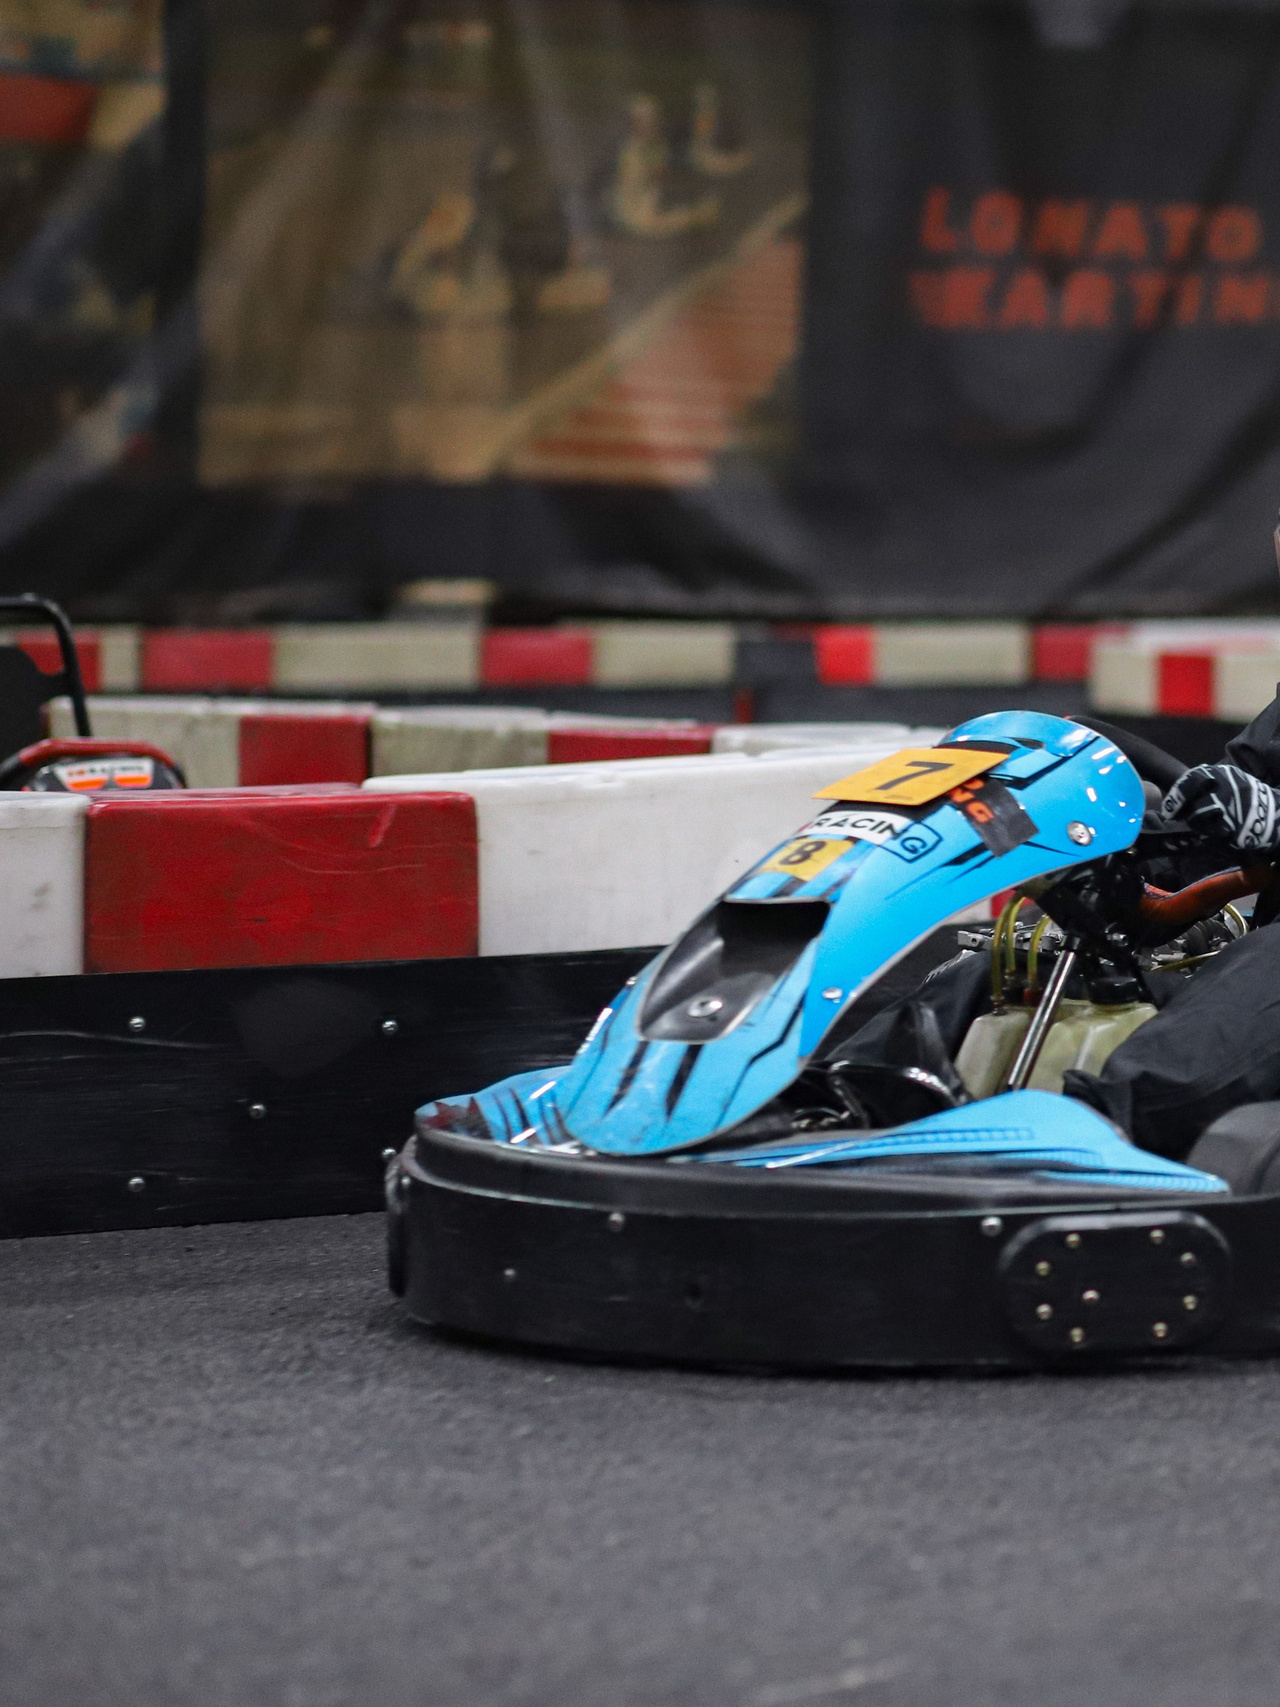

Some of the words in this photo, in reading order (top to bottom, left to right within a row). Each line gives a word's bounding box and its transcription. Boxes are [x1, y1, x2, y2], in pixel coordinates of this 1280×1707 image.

[920, 186, 1260, 261] LONATO
[874, 760, 954, 791] 7
[778, 840, 828, 866] 8
[809, 817, 927, 855] RACING
